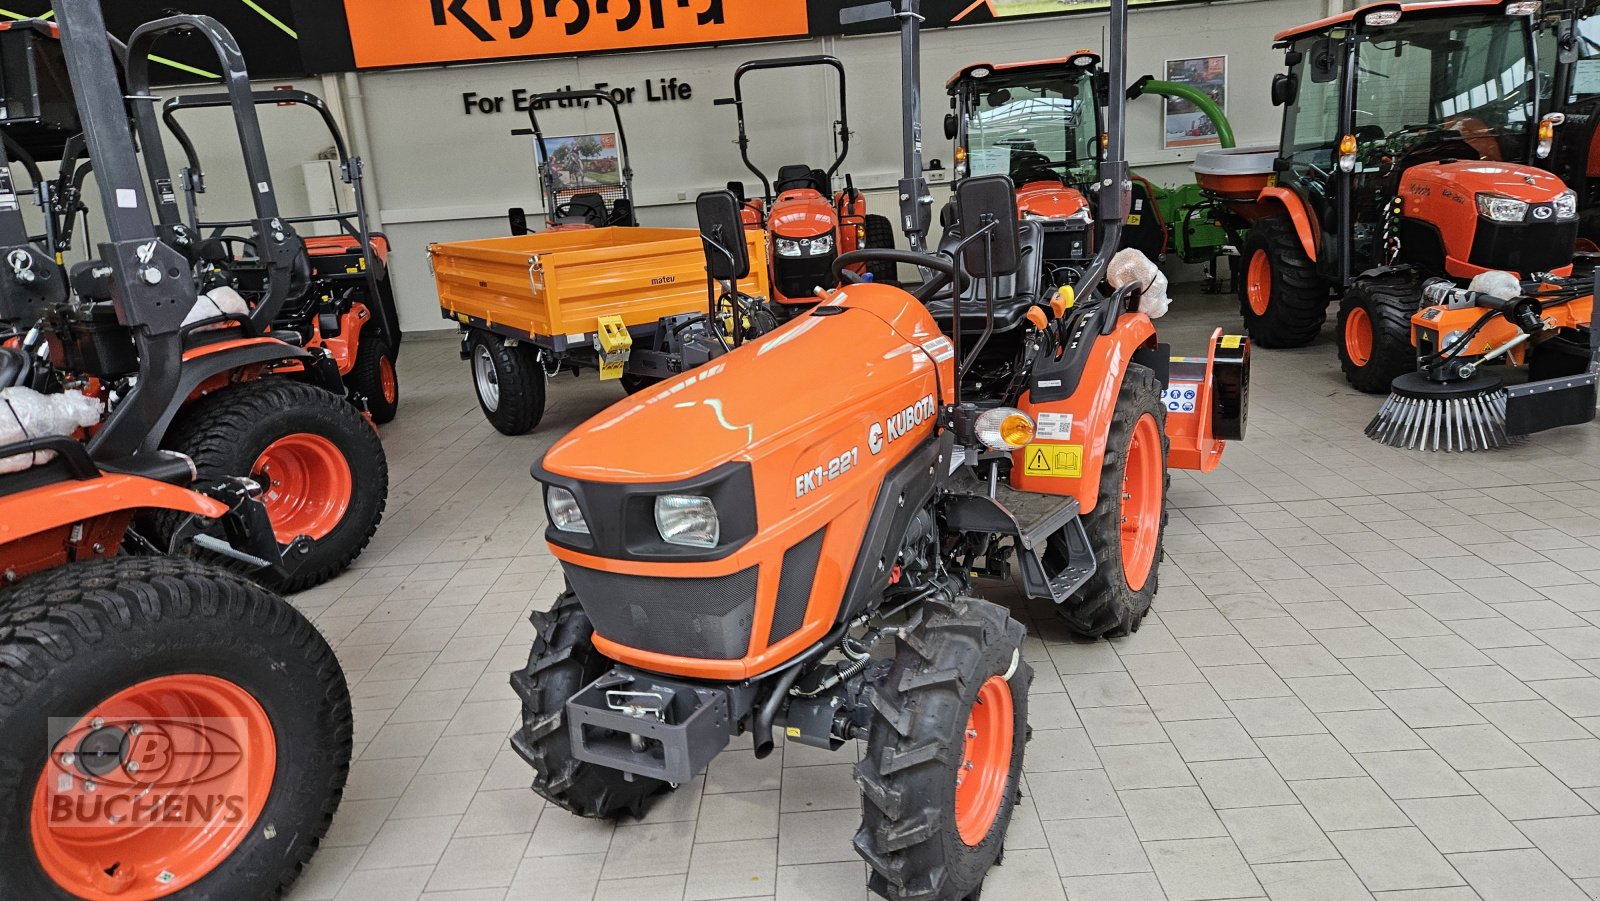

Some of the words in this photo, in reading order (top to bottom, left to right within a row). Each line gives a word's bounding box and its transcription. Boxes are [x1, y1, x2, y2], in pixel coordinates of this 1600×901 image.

[462, 92, 504, 115] For
[594, 81, 635, 106] For
[645, 77, 692, 102] Life
[886, 393, 936, 443] KUBOTA
[795, 446, 858, 498] EK1-221
